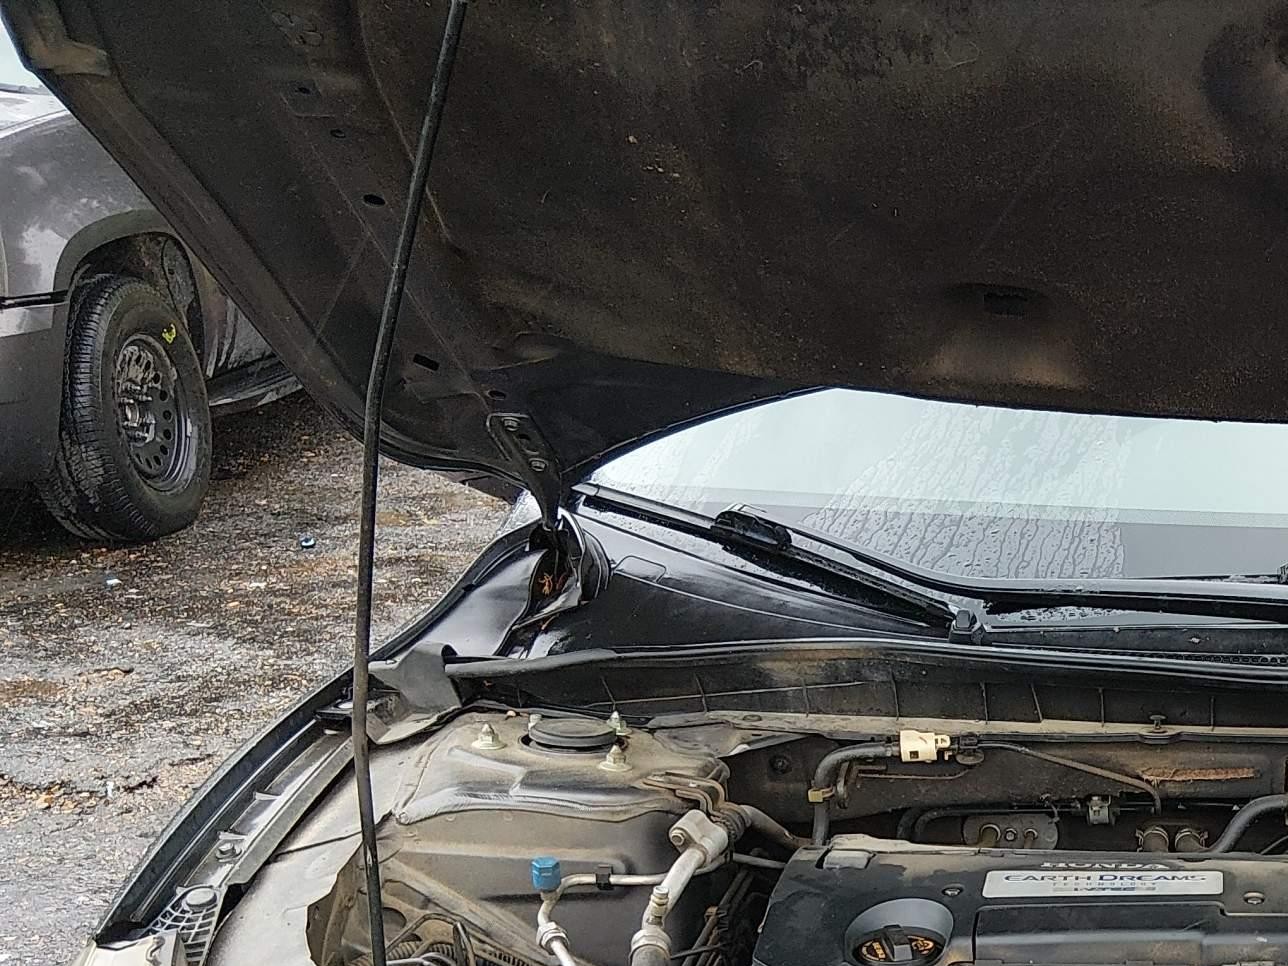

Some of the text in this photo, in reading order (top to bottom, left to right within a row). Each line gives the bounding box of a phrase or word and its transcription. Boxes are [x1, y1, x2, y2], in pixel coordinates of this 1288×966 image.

[1040, 861, 1170, 870] HONDA
[1004, 873, 1207, 882] EARTH DREAMS
